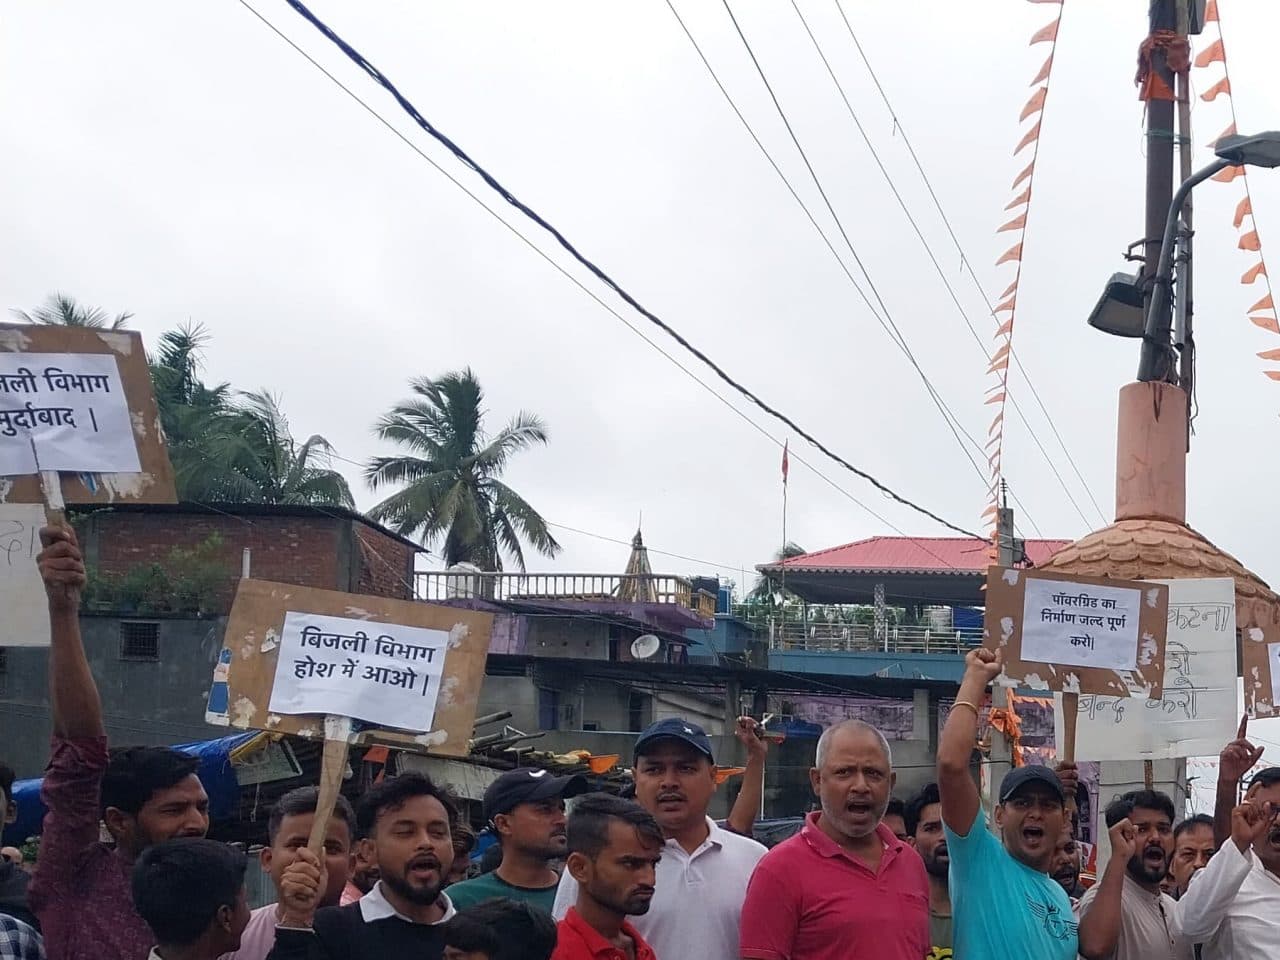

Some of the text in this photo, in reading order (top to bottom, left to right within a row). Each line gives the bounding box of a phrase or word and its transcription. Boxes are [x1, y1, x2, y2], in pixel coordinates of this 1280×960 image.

[43, 367, 110, 393] विभाग
[1101, 597, 1117, 610] का
[1041, 609, 1126, 632] निर्माण जल्द पूर्ण
[300, 626, 437, 663] बिजली विभाग
[294, 655, 336, 679] होश
[342, 658, 359, 678] में
[362, 665, 417, 689] आओ
